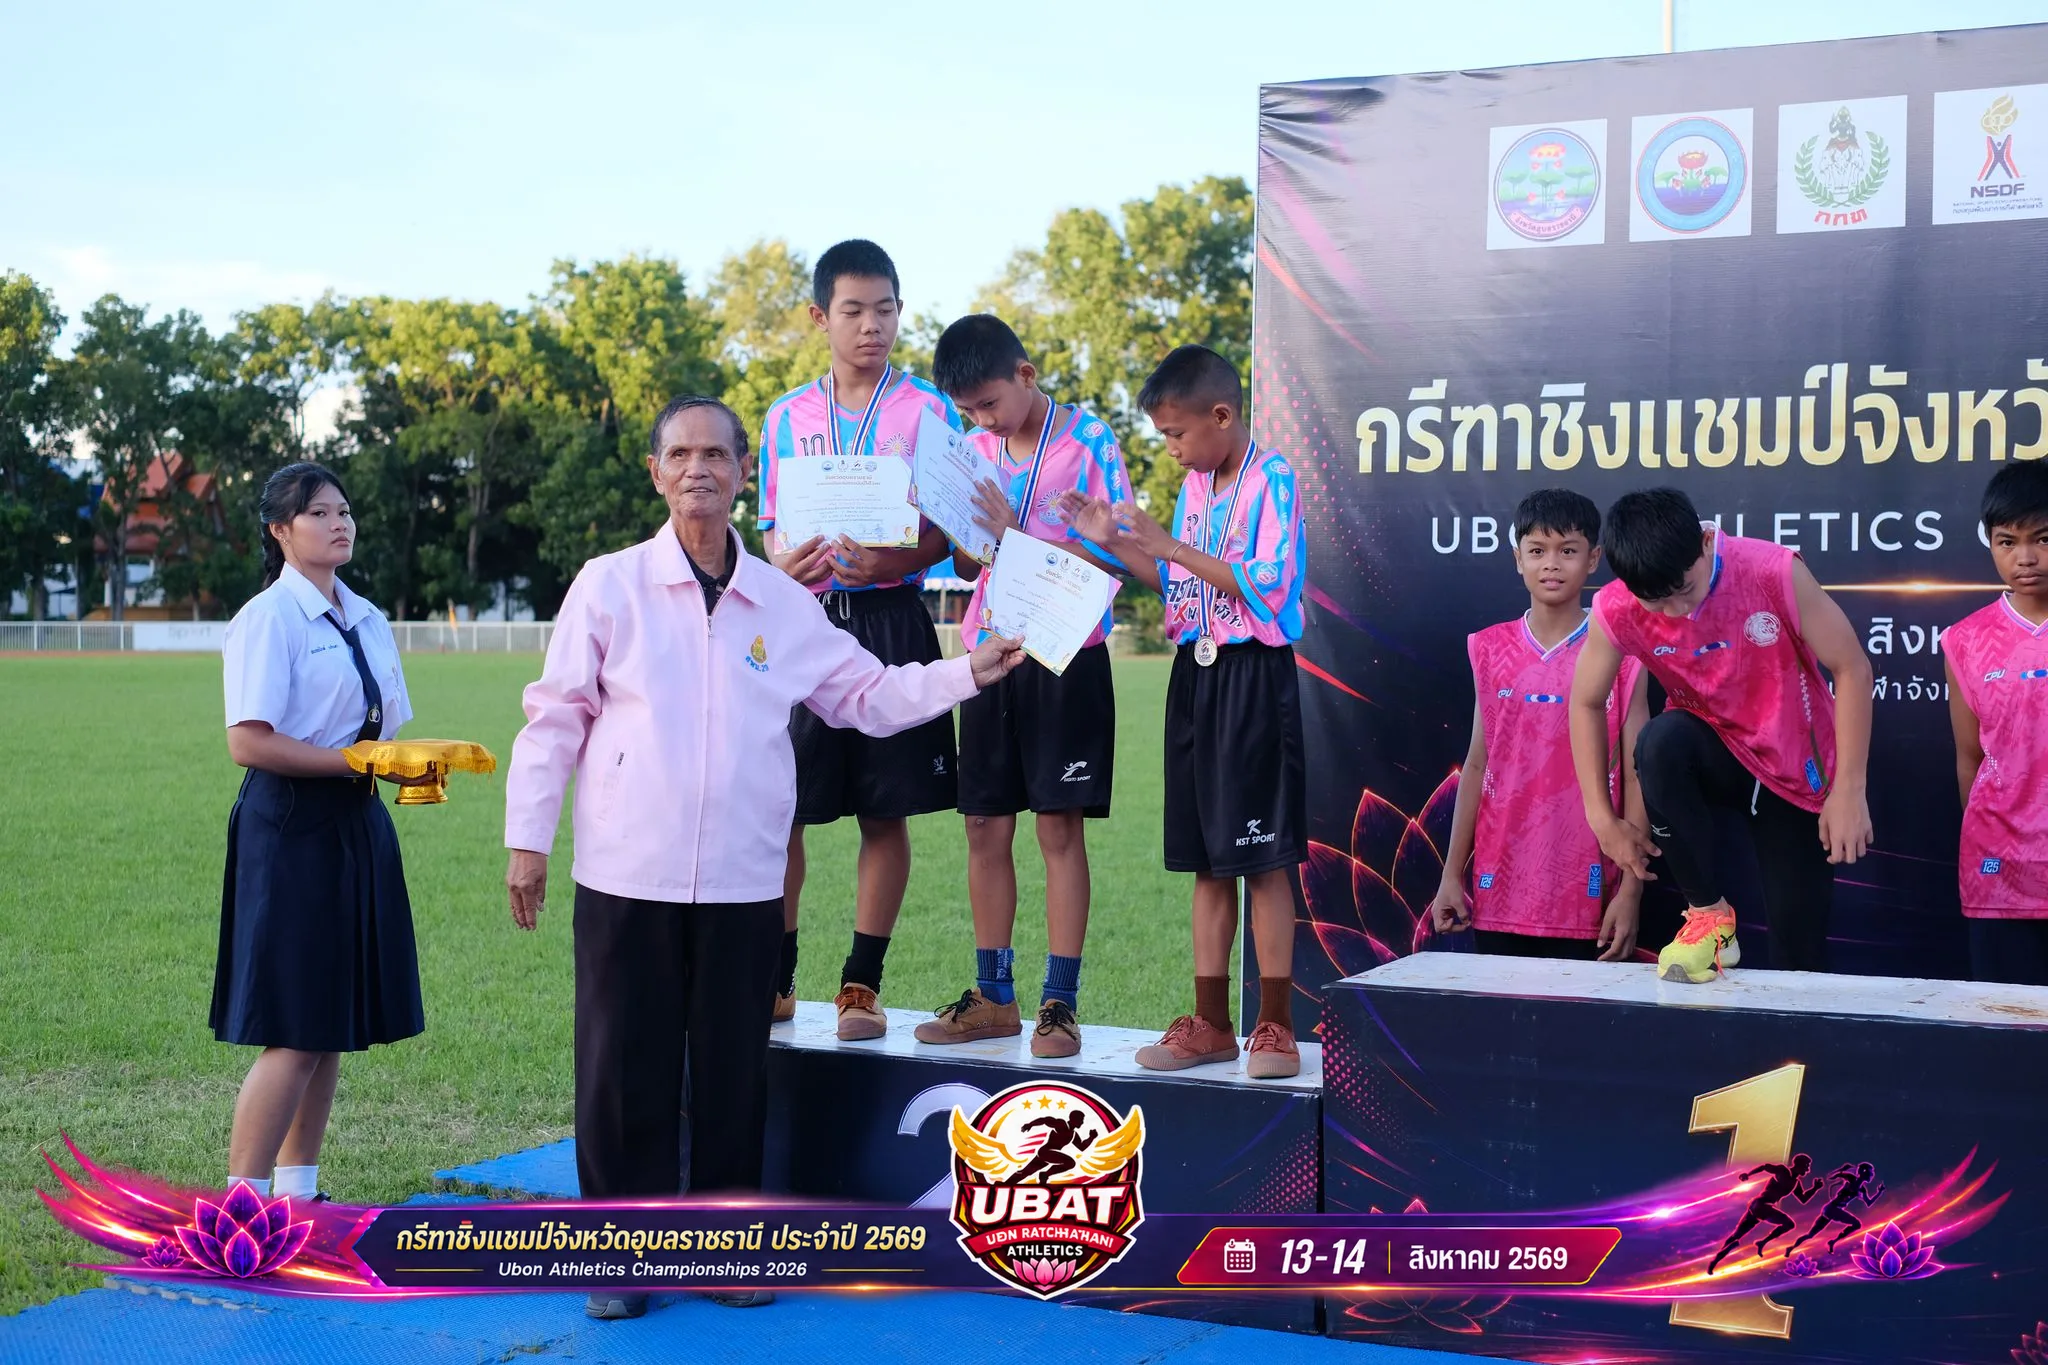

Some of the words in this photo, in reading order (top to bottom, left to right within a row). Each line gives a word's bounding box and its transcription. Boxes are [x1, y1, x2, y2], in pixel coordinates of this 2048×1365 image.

[1970, 183, 2025, 198] NSDF
[1814, 208, 1868, 226] กกท
[1431, 516, 1519, 554] UB
[1653, 646, 1676, 656] CPU
[1983, 669, 2006, 682] CPU
[1235, 837, 1250, 847] KST
[1251, 833, 1276, 844] SPORT
